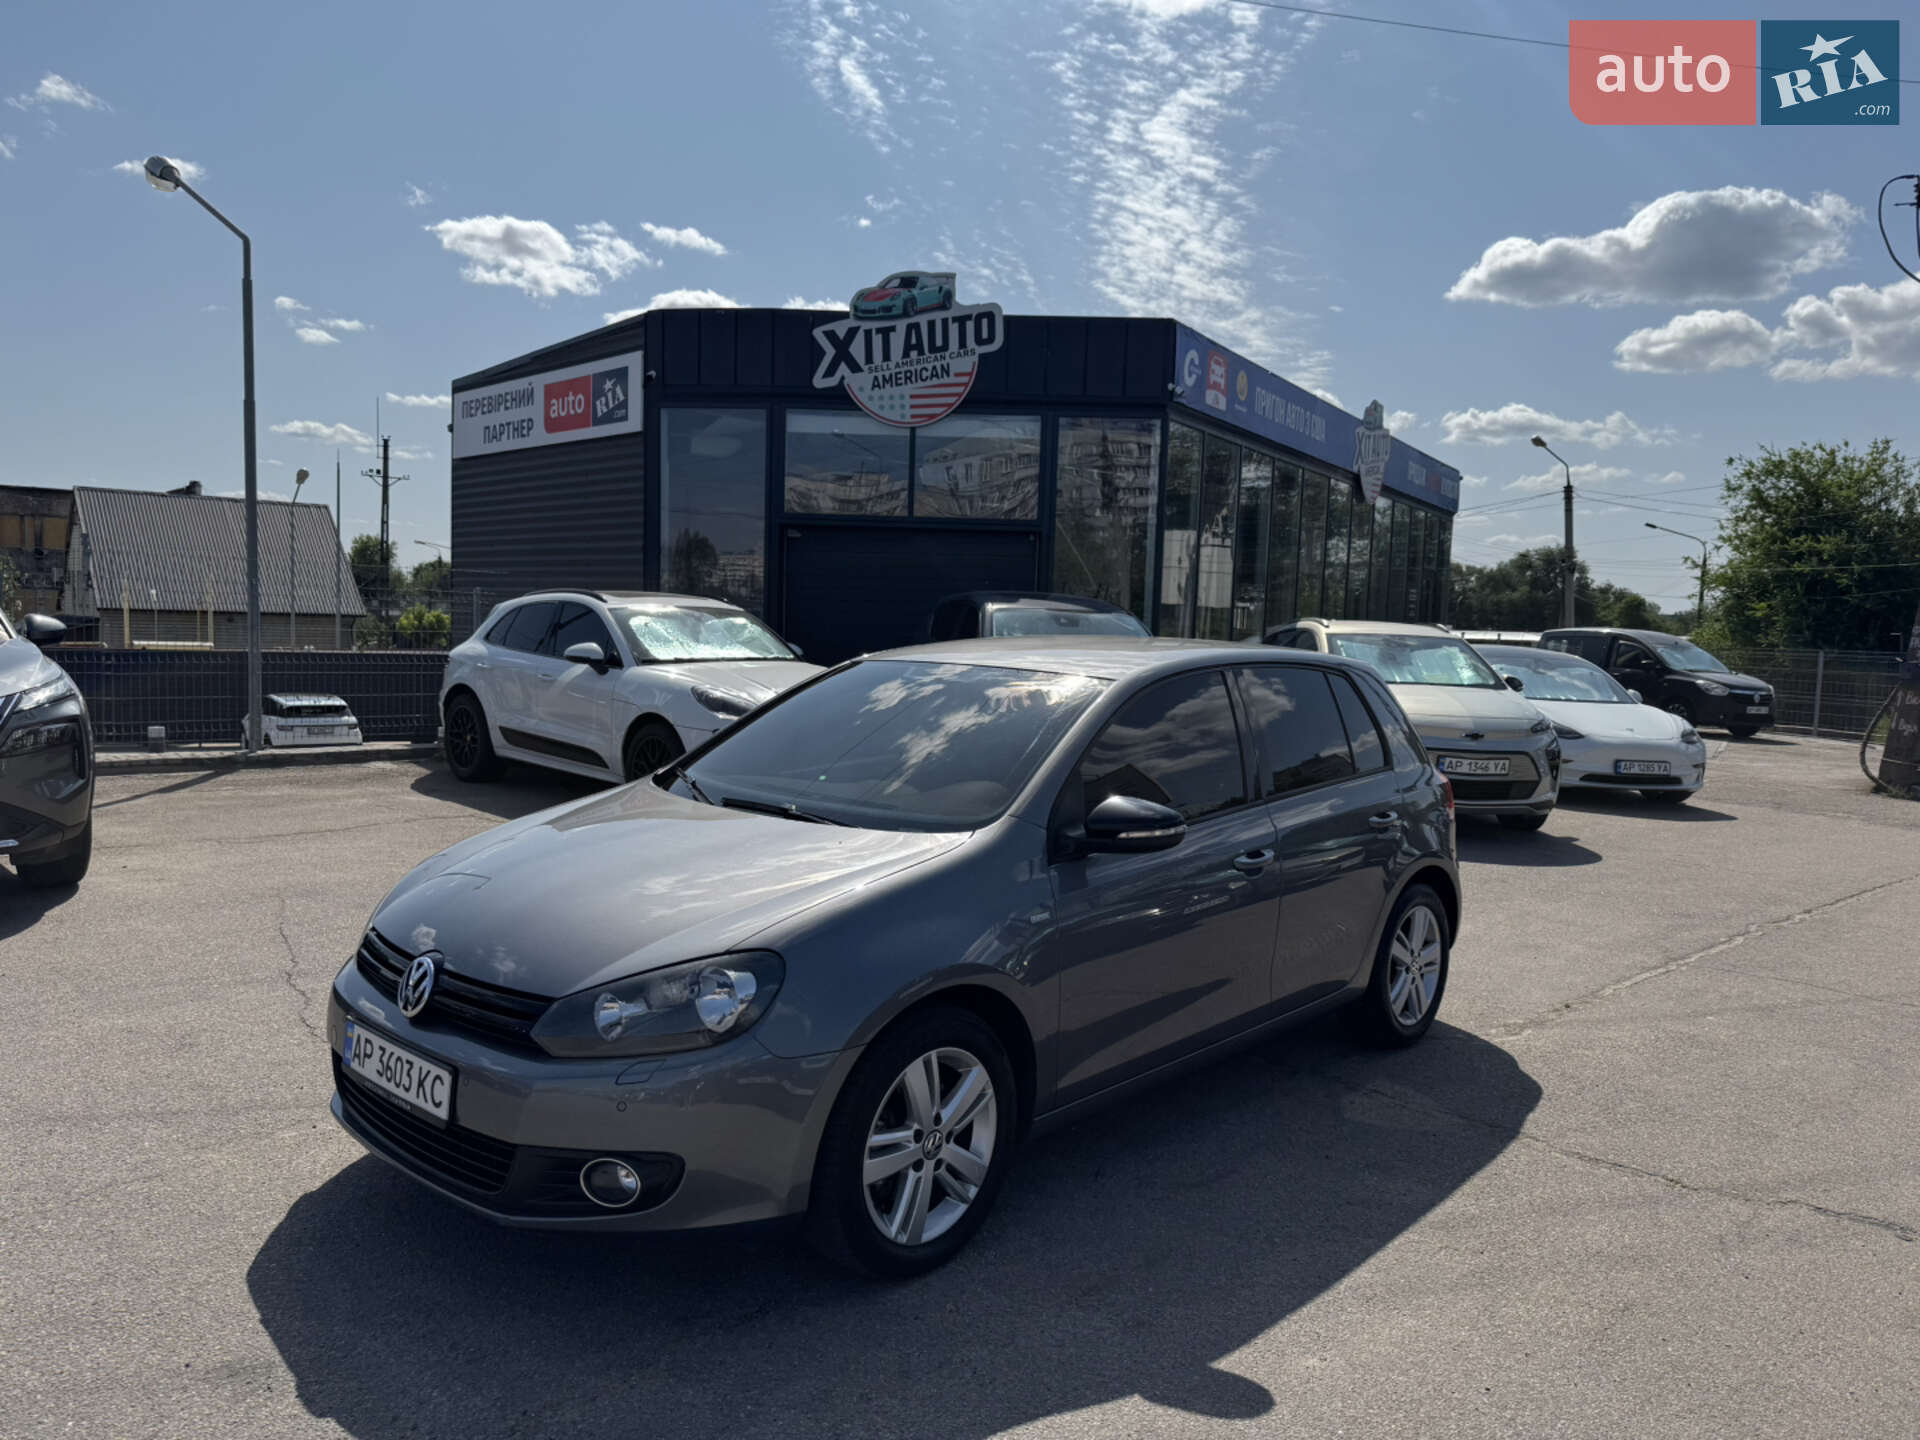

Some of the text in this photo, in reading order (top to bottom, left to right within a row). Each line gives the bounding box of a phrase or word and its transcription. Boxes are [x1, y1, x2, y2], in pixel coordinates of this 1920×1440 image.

[867, 348, 977, 375] SELL AMERICAN CARS
[871, 363, 950, 391] AMERICAN
[461, 383, 535, 419] ПЕРЕВІРЕНИЙ
[550, 384, 625, 418] auto RIA
[483, 418, 535, 444] ПАРТНЕР
[352, 1033, 374, 1069] AP
[376, 1045, 414, 1093] 3603
[416, 1066, 445, 1109] KC
